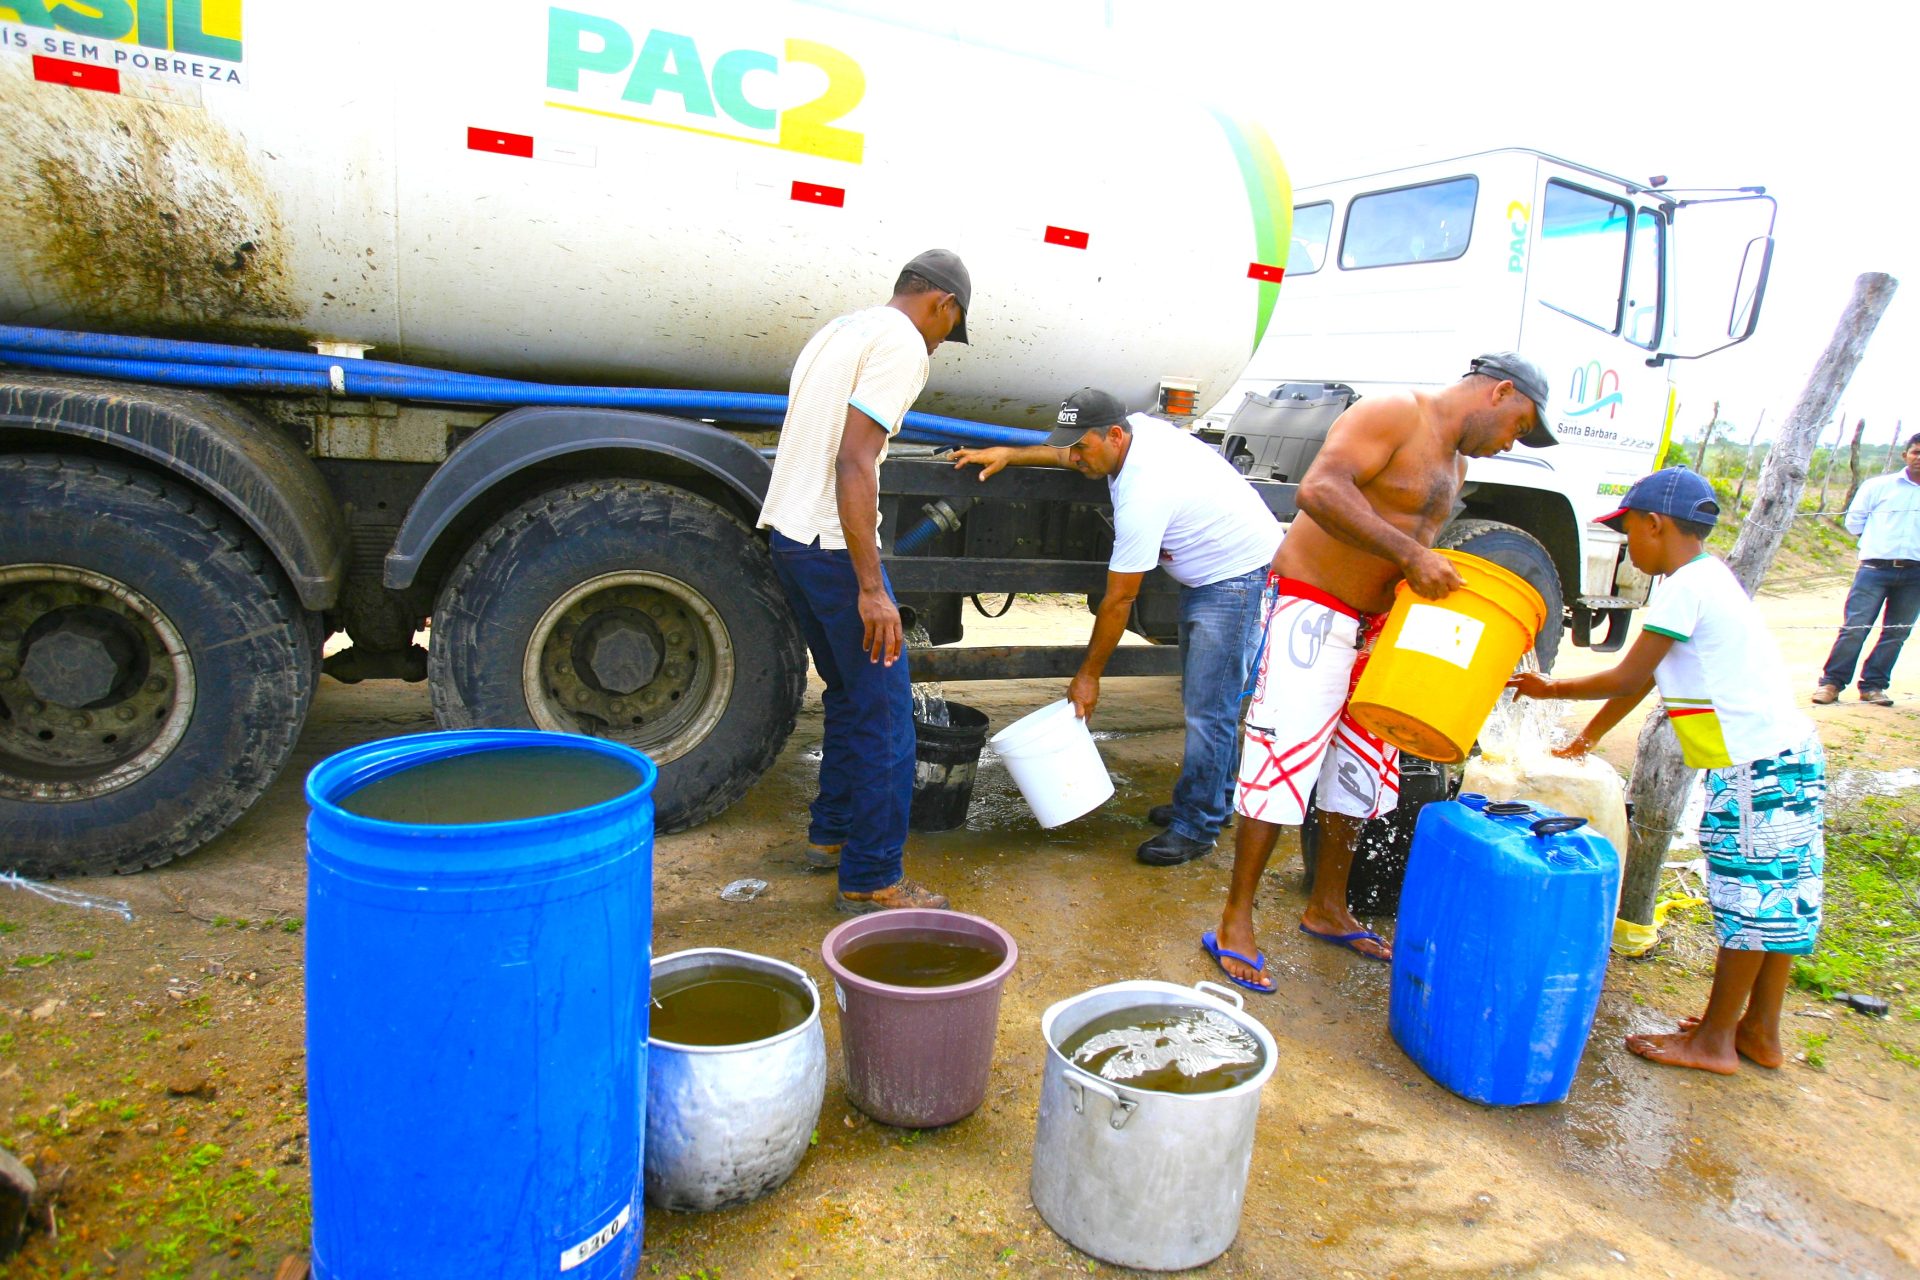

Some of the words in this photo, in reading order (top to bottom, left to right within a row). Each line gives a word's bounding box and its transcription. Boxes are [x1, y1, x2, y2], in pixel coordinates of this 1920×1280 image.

[43, 37, 99, 60] SEM
[114, 49, 241, 84] POBREZA
[546, 6, 866, 165] PAC2
[1506, 199, 1531, 273] PAC2
[1557, 422, 1582, 436] Santa
